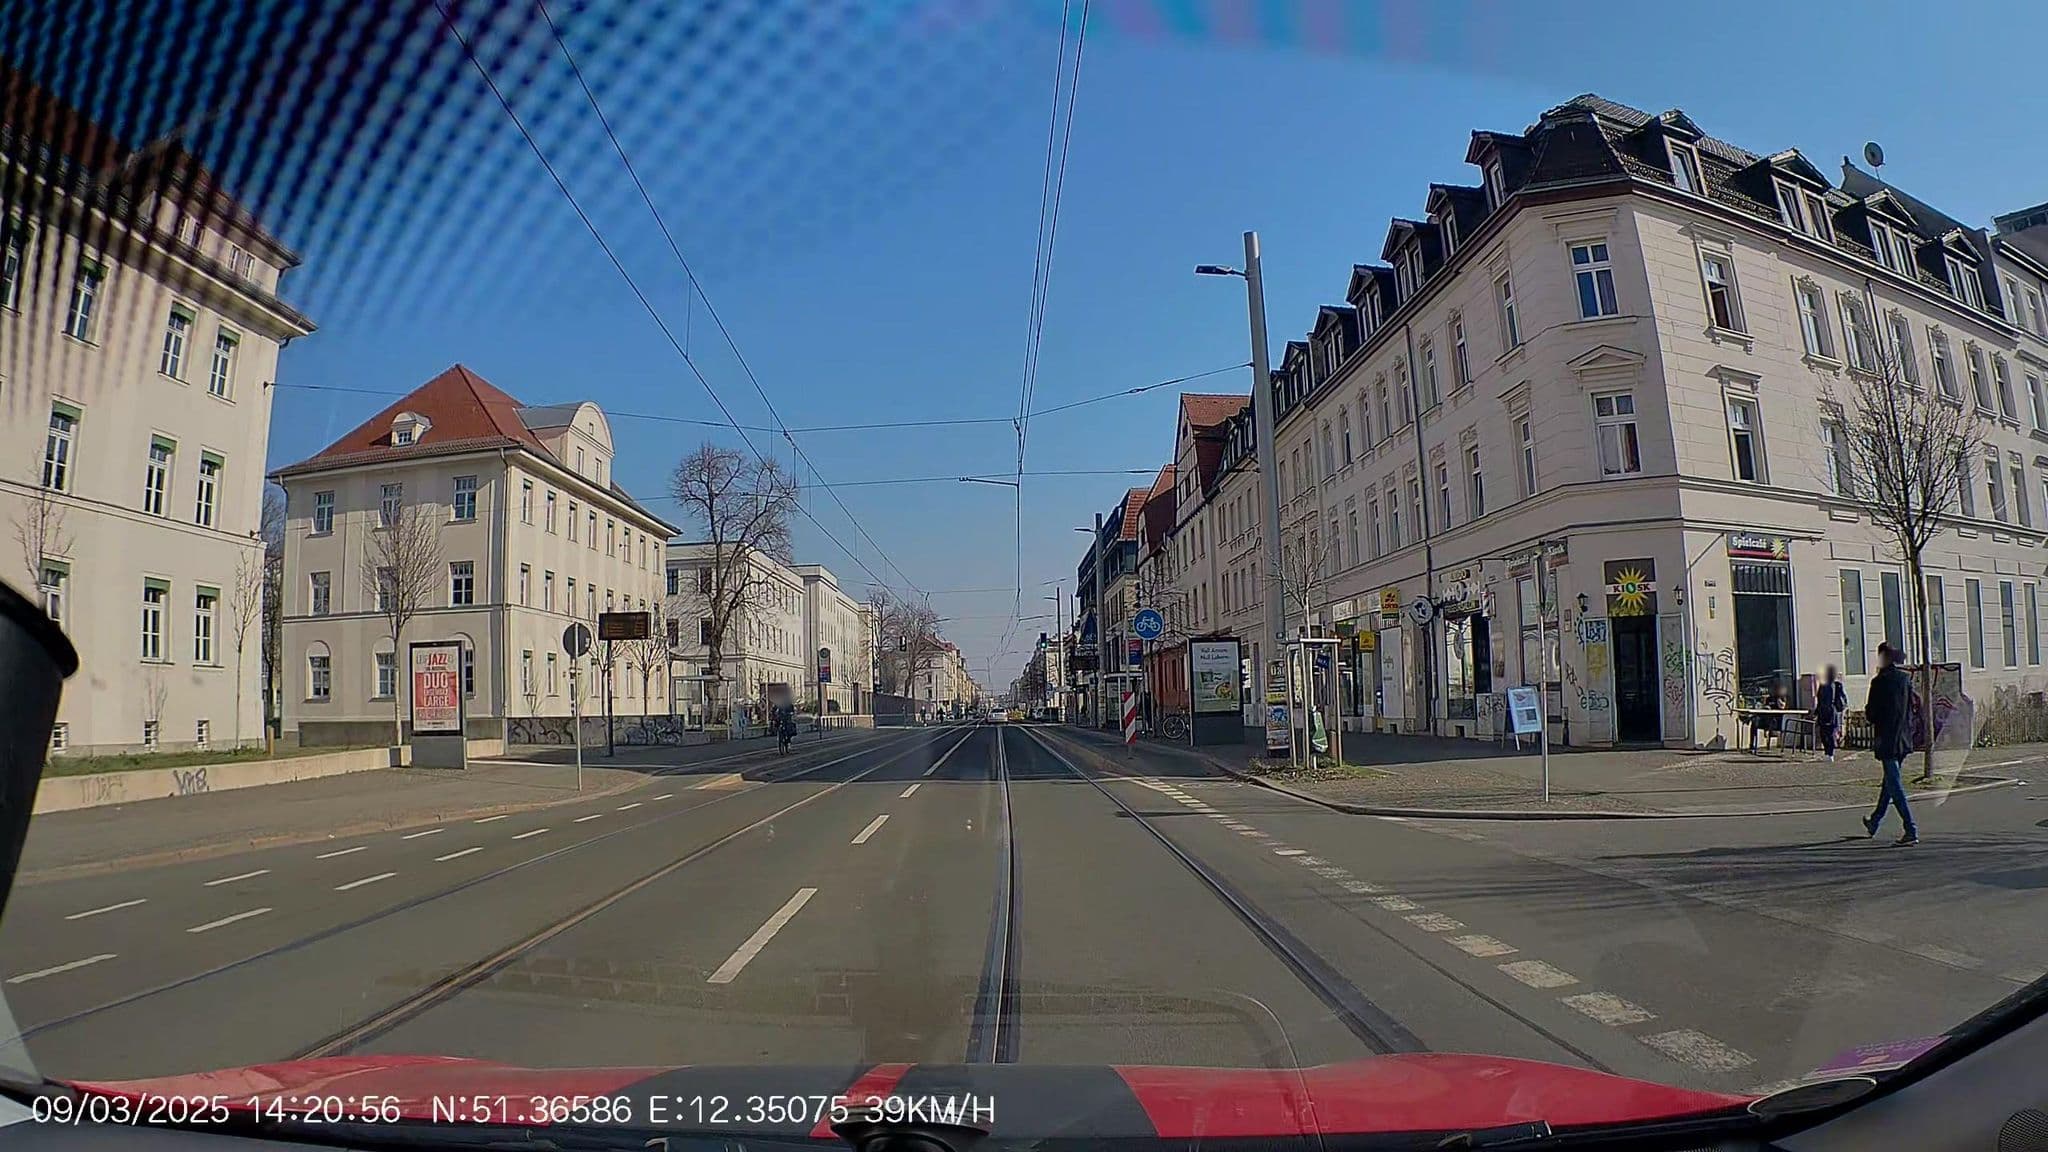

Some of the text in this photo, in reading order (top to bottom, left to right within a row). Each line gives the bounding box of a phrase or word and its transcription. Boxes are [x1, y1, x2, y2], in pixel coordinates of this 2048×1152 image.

[427, 653, 448, 665] JAZZ
[423, 672, 449, 689] DUO
[423, 695, 449, 707] LARGE
